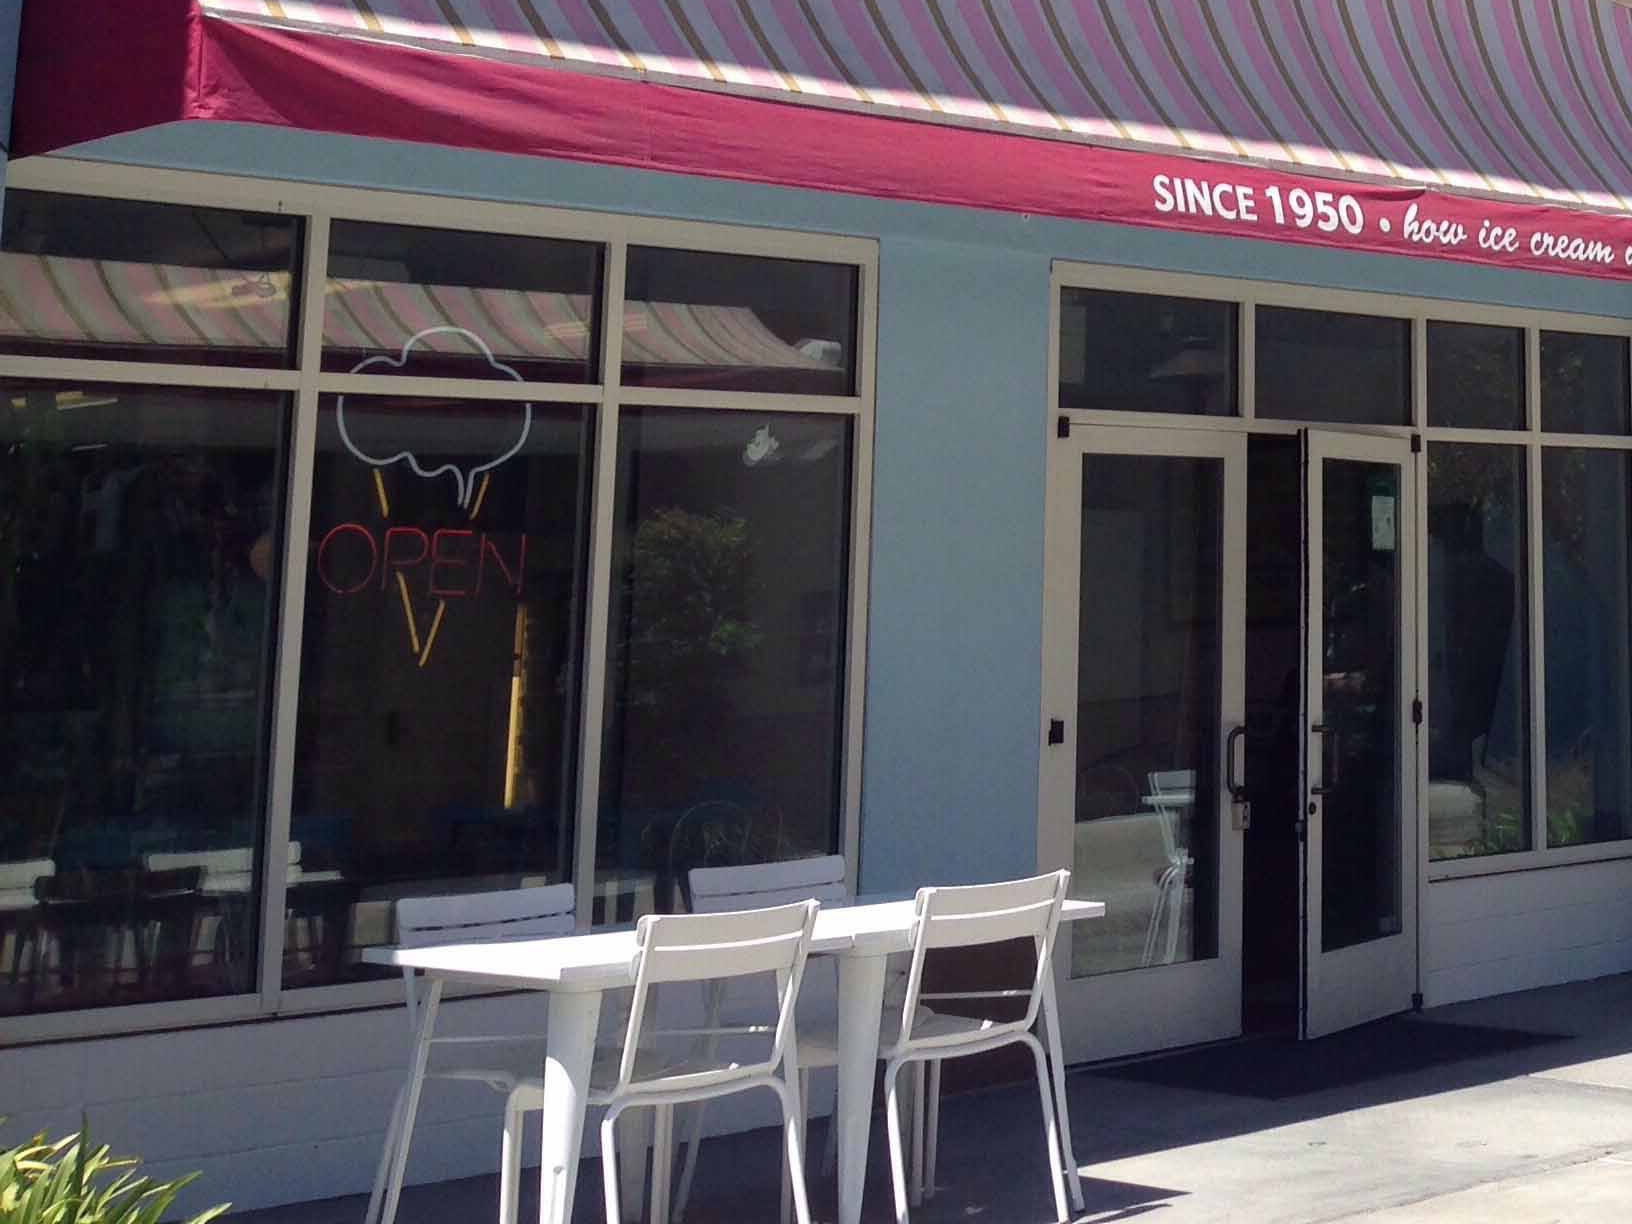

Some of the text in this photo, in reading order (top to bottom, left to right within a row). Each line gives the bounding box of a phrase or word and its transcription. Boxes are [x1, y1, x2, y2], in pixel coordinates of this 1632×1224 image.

[1152, 174, 1258, 223] SINCE
[1264, 185, 1364, 234] 1950
[1403, 203, 1467, 245] how
[1477, 218, 1519, 252] ice
[1529, 230, 1614, 264] cream
[317, 523, 527, 596] OPEN
